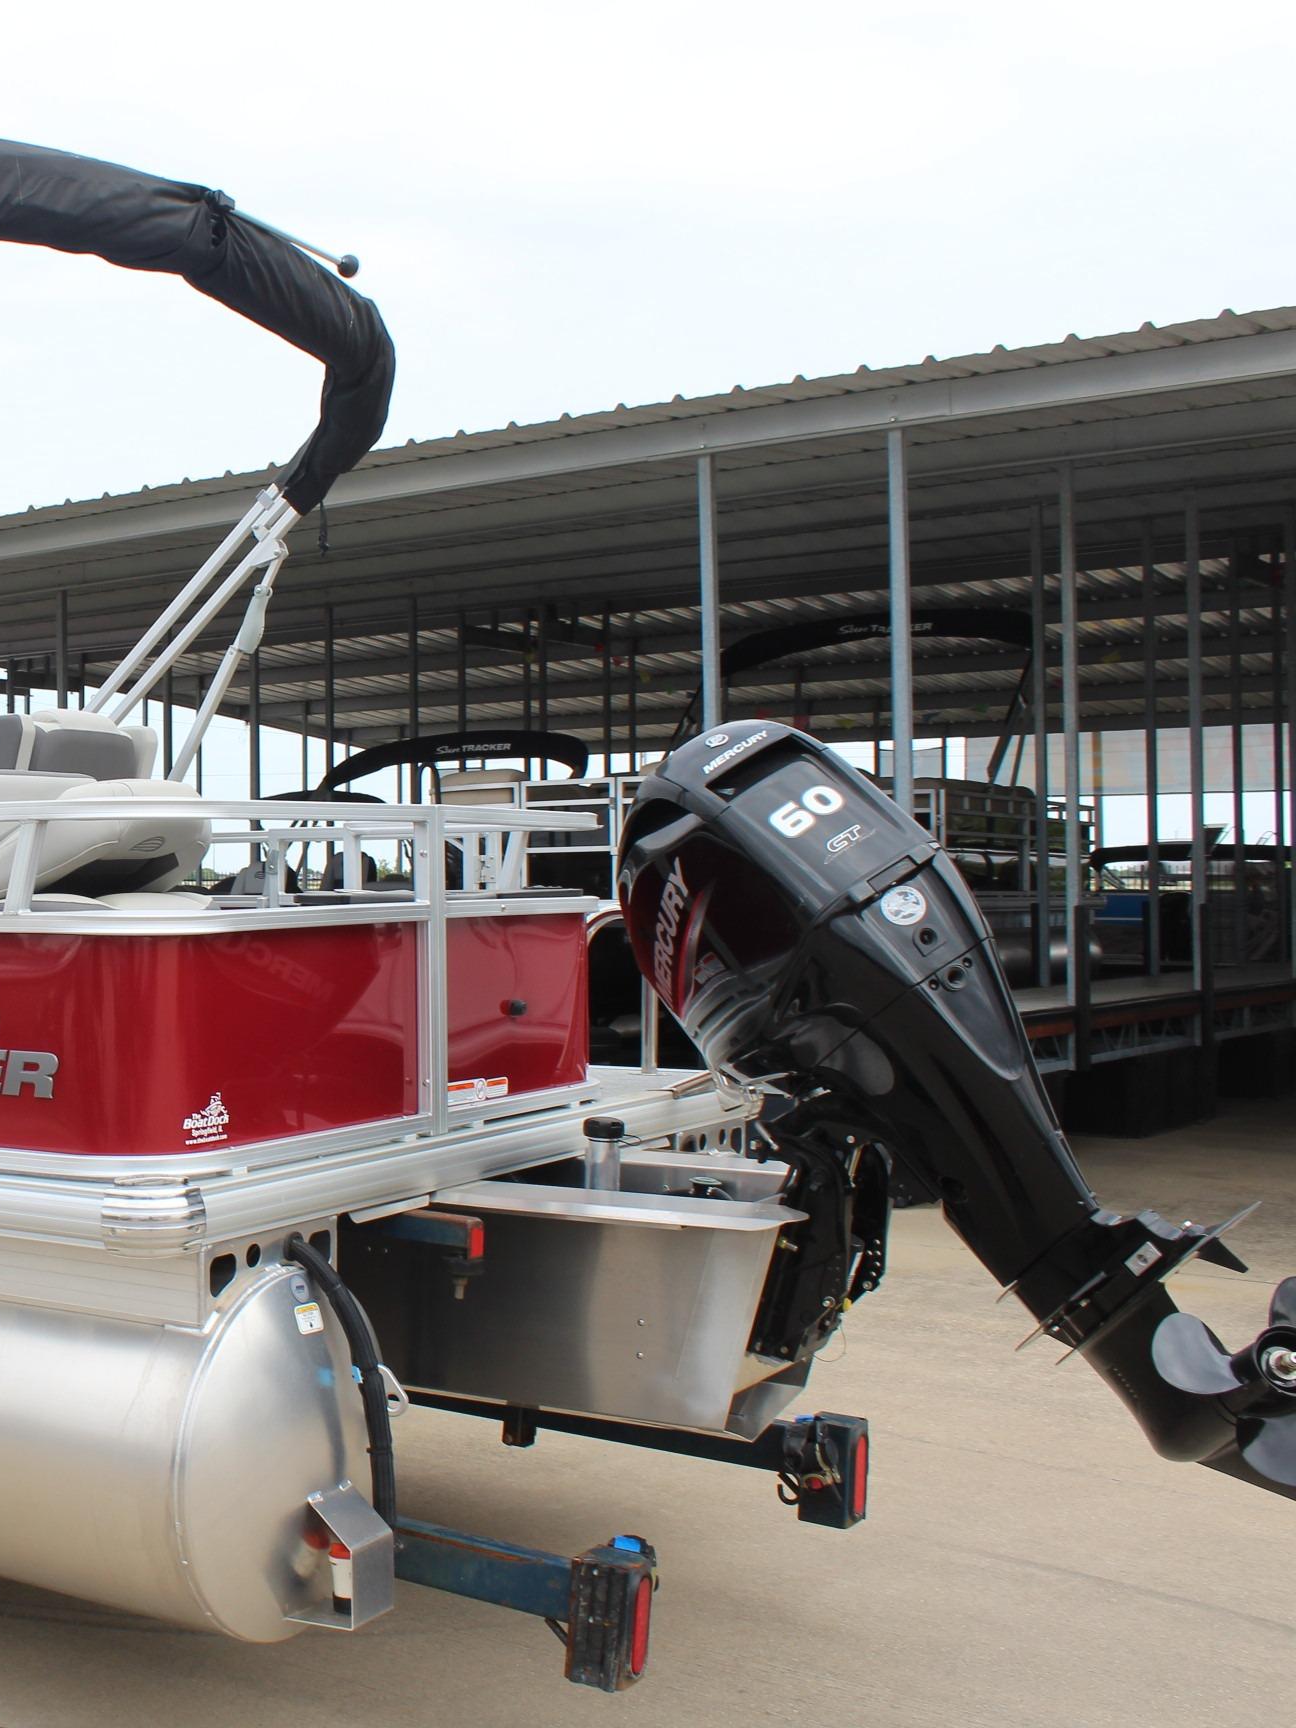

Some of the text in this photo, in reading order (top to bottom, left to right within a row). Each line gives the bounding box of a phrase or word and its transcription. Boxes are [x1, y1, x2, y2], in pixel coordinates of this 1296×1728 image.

[436, 743, 511, 754] Sun TRACKER
[703, 730, 769, 774] MERCURY
[769, 785, 843, 837] 60
[655, 856, 689, 1010] MERCURY
